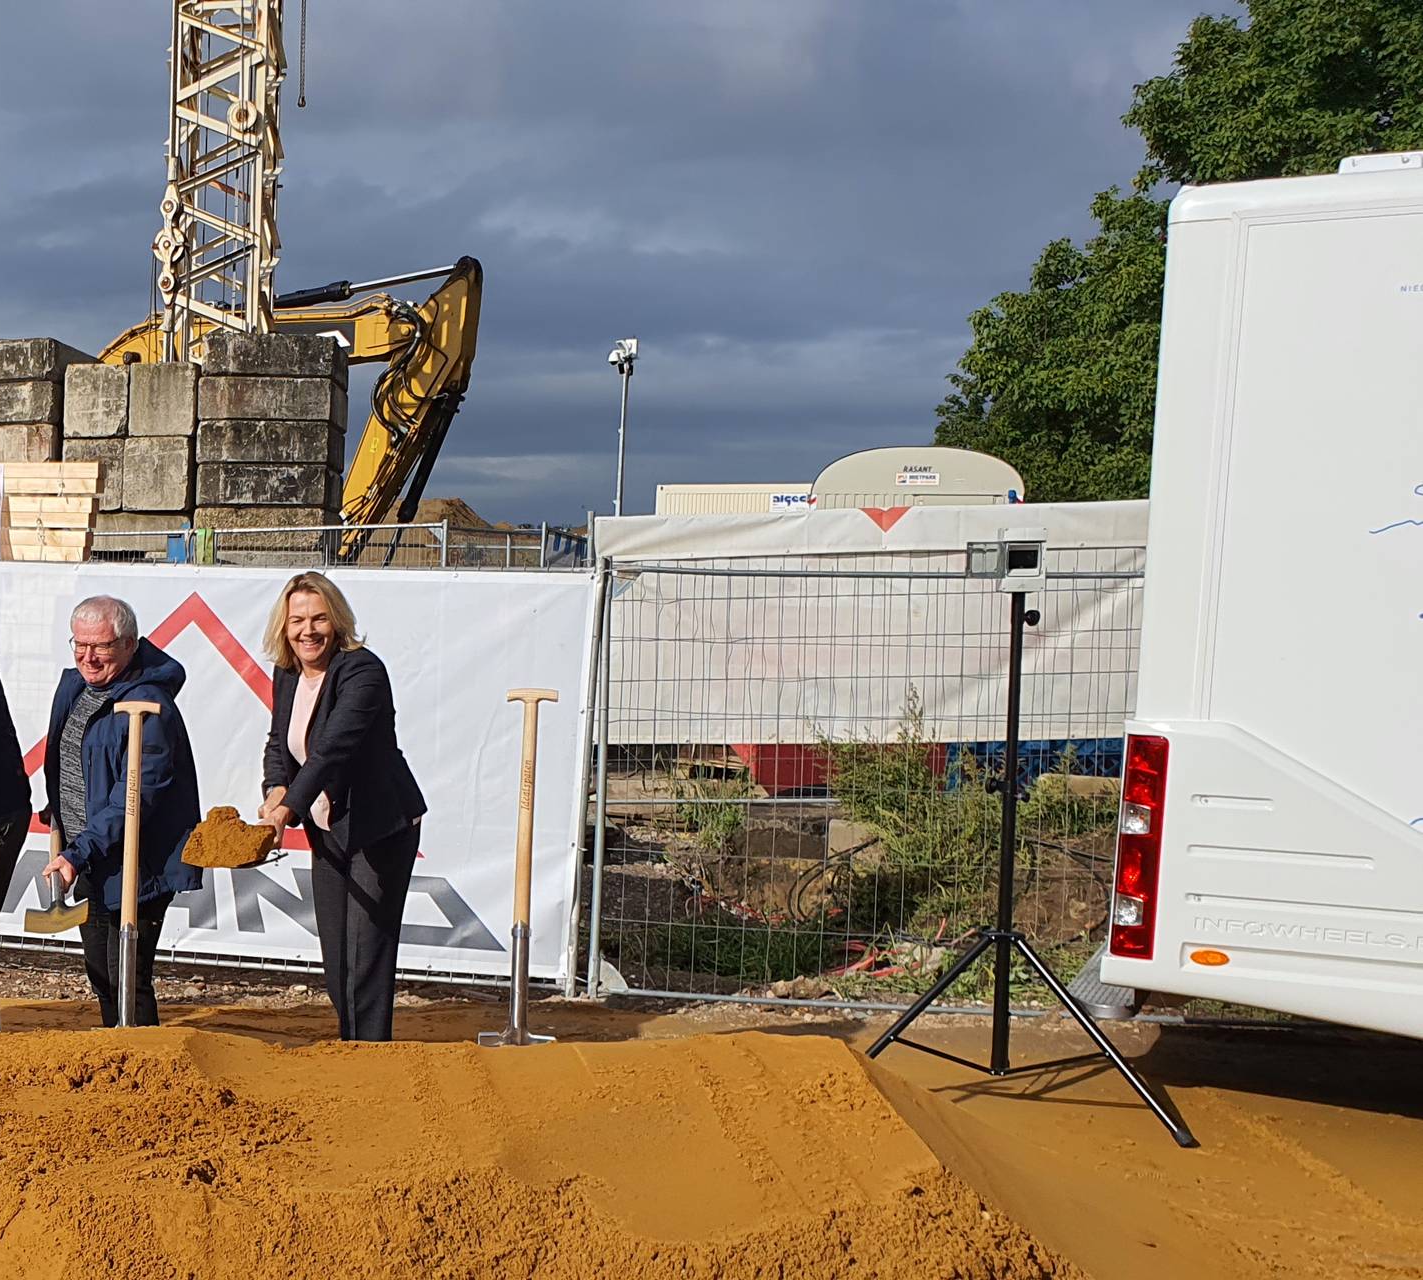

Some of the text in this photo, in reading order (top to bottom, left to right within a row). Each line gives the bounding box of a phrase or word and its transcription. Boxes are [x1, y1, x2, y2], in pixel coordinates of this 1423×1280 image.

[903, 465, 932, 473] RASANT
[127, 769, 137, 816] Idealspaten
[521, 759, 534, 811] Idealspaten
